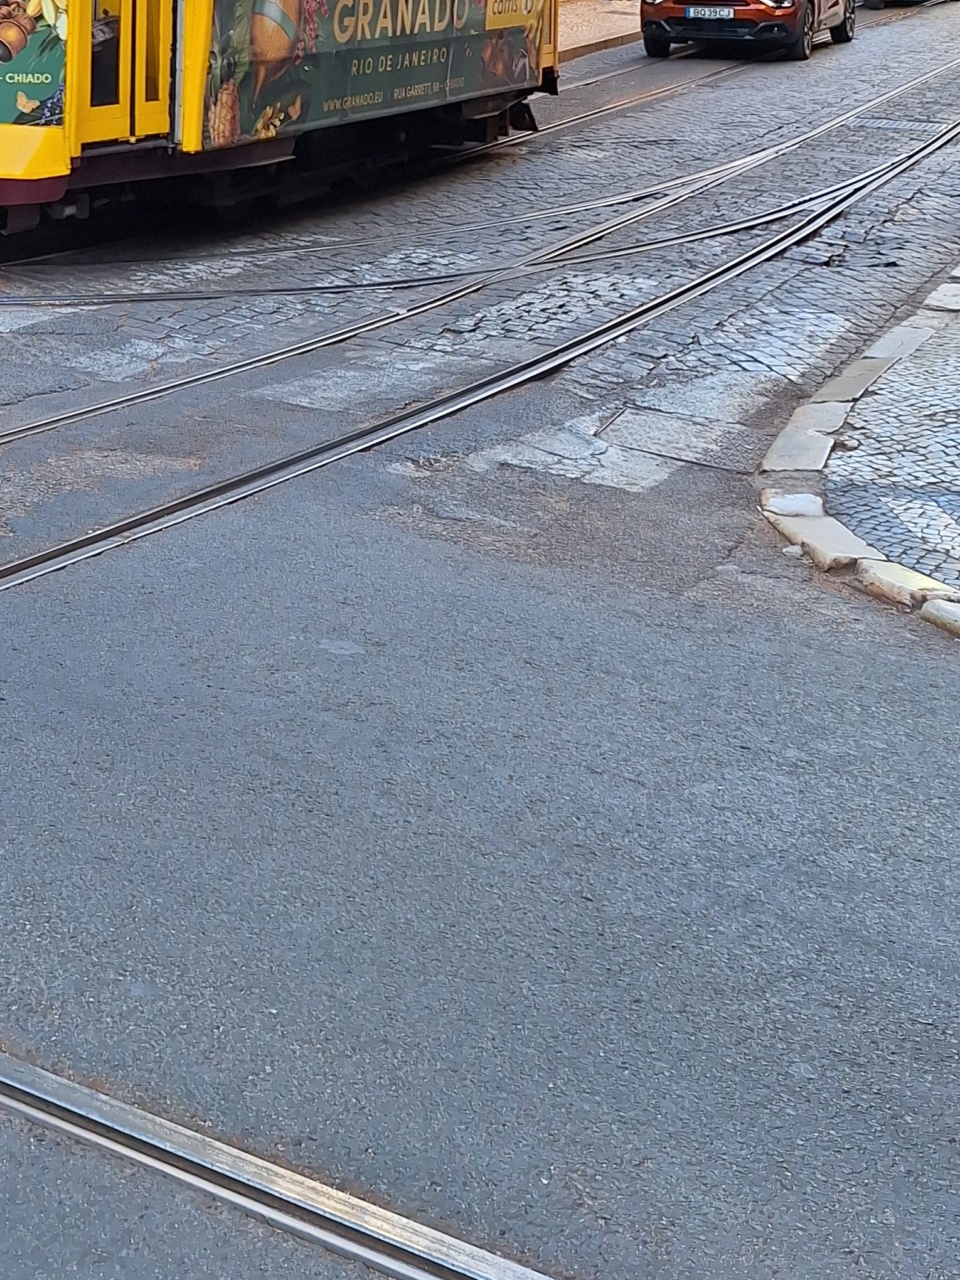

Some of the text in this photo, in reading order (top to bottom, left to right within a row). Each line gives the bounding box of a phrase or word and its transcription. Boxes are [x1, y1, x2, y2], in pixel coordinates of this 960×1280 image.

[351, 47, 447, 76] RIO DE JANEIRO
[5, 73, 52, 84] CHIADO
[322, 91, 384, 113] WWW.GRANADO.EU
[393, 87, 407, 100] RUA
